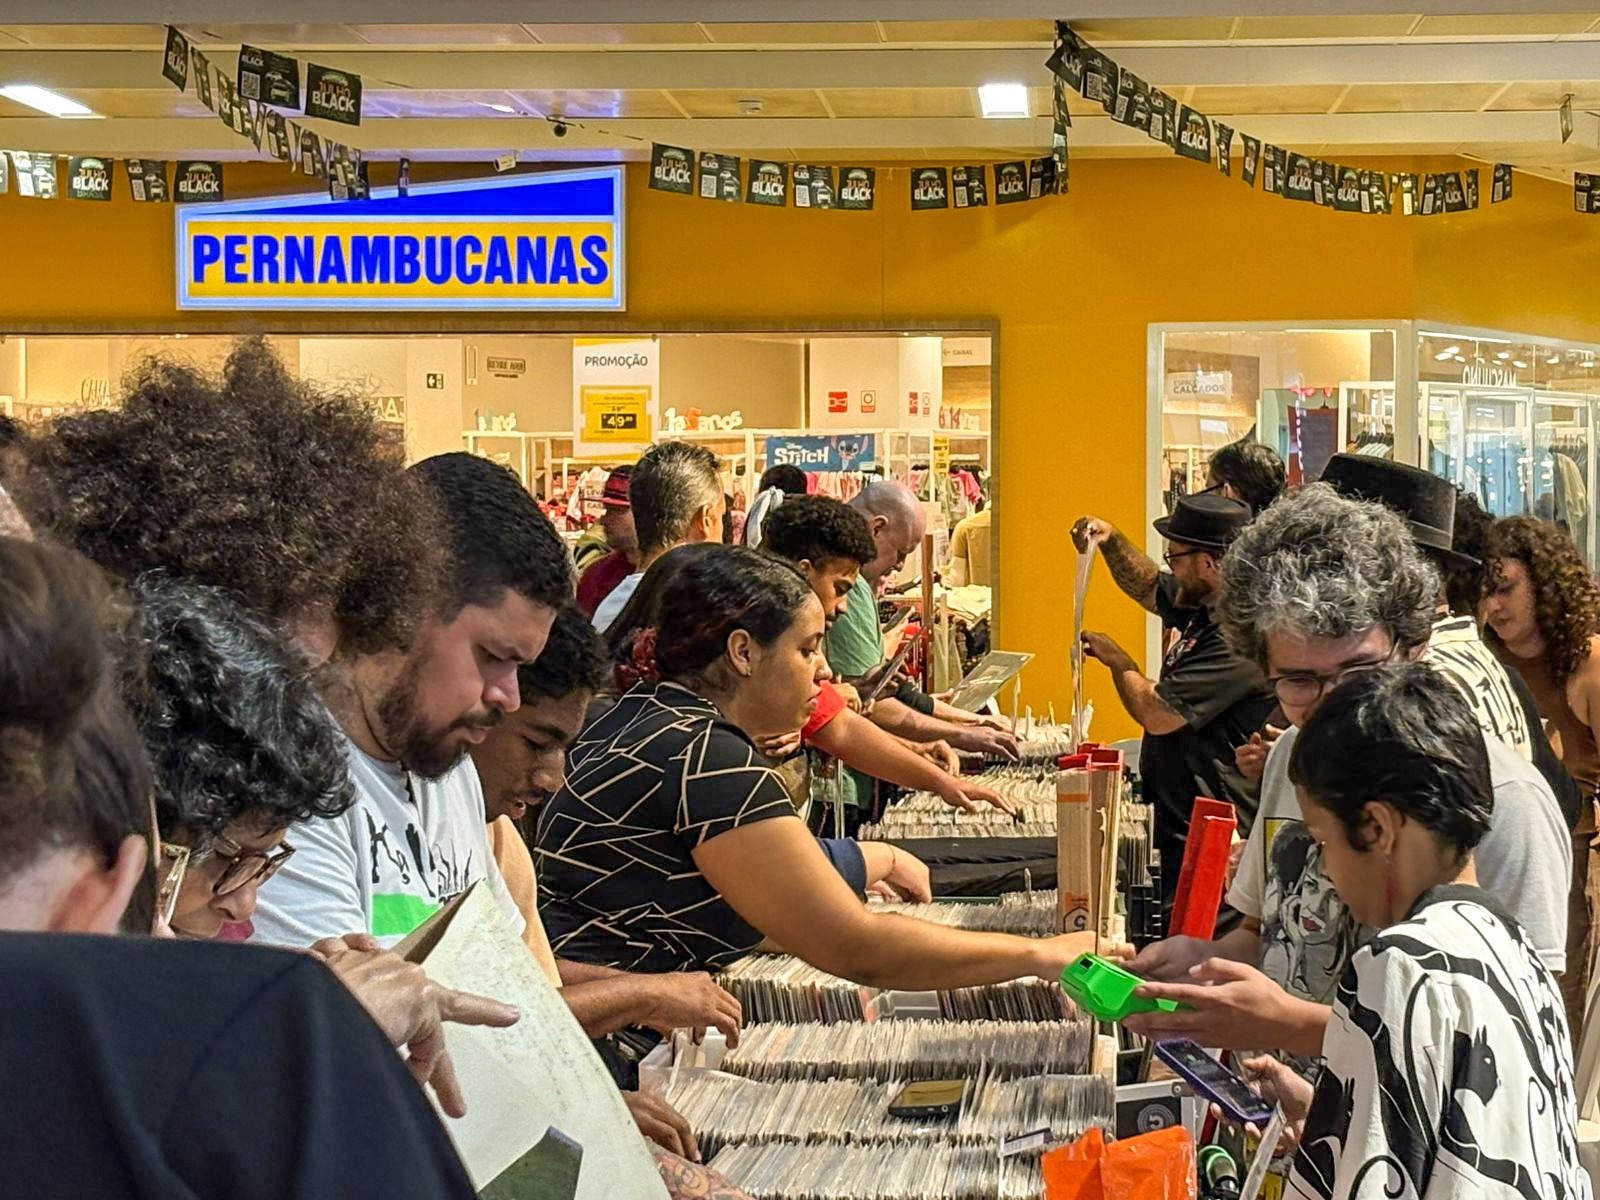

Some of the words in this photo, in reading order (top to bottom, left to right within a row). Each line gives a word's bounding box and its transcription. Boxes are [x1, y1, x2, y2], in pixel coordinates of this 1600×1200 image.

[319, 81, 351, 98] JULHO
[312, 91, 355, 112] BLACK
[1181, 131, 1208, 150] BLACK
[78, 168, 107, 180] JULHO
[185, 172, 215, 182] JULHO
[654, 166, 691, 183] BLACK
[73, 176, 109, 191] BLACK
[179, 180, 219, 193] BLACK
[752, 181, 784, 196] BLACK
[998, 181, 1024, 195] BLACK
[1288, 175, 1312, 190] BLACK
[841, 187, 871, 200] BLACK
[914, 187, 945, 200] BLACK
[1337, 187, 1360, 202] BLACK
[192, 235, 608, 285] PERNAMBUCANAS
[584, 353, 649, 369] PROMOÇÃO
[1173, 384, 1226, 394] CALÇADOS
